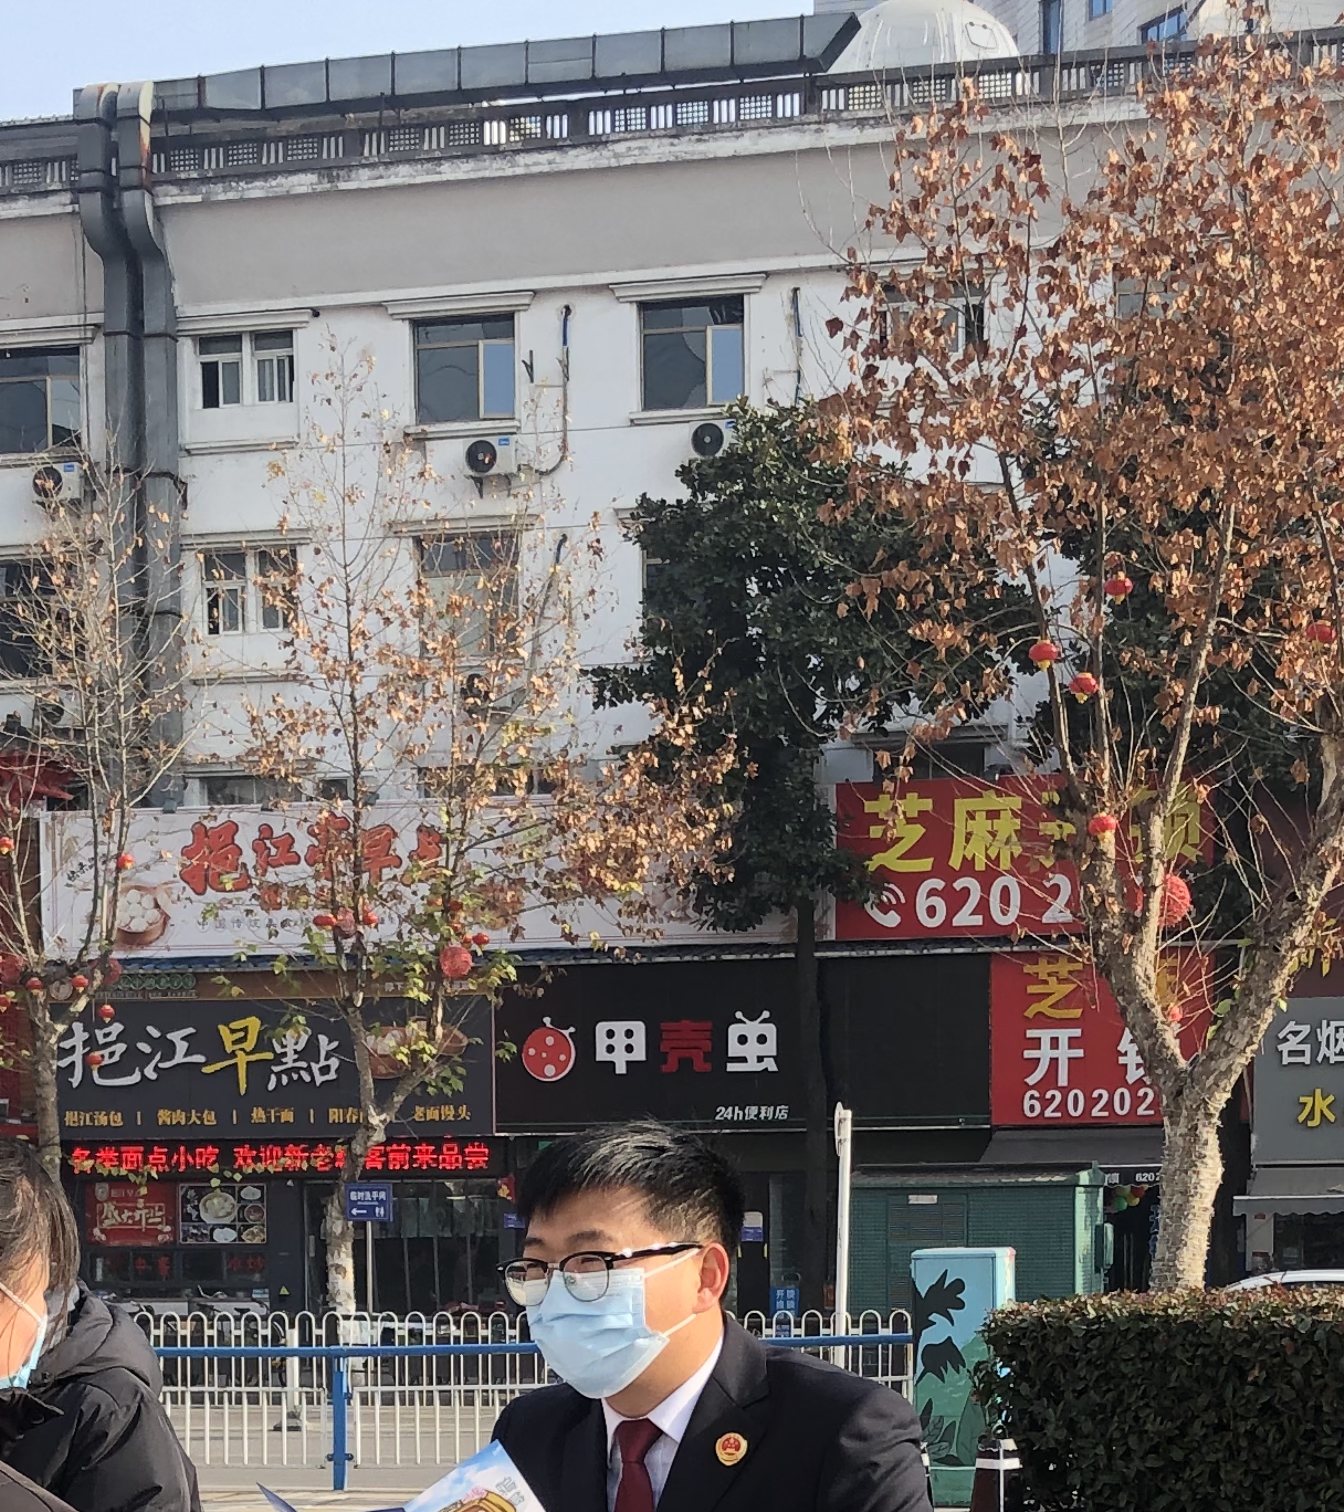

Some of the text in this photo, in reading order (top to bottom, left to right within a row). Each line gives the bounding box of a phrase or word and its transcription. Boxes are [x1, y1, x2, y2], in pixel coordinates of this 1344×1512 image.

[595, 1009, 779, 1075] 甲壳虫
[328, 1109, 364, 1124] 阳春
[714, 1104, 790, 1121] 24h便利店
